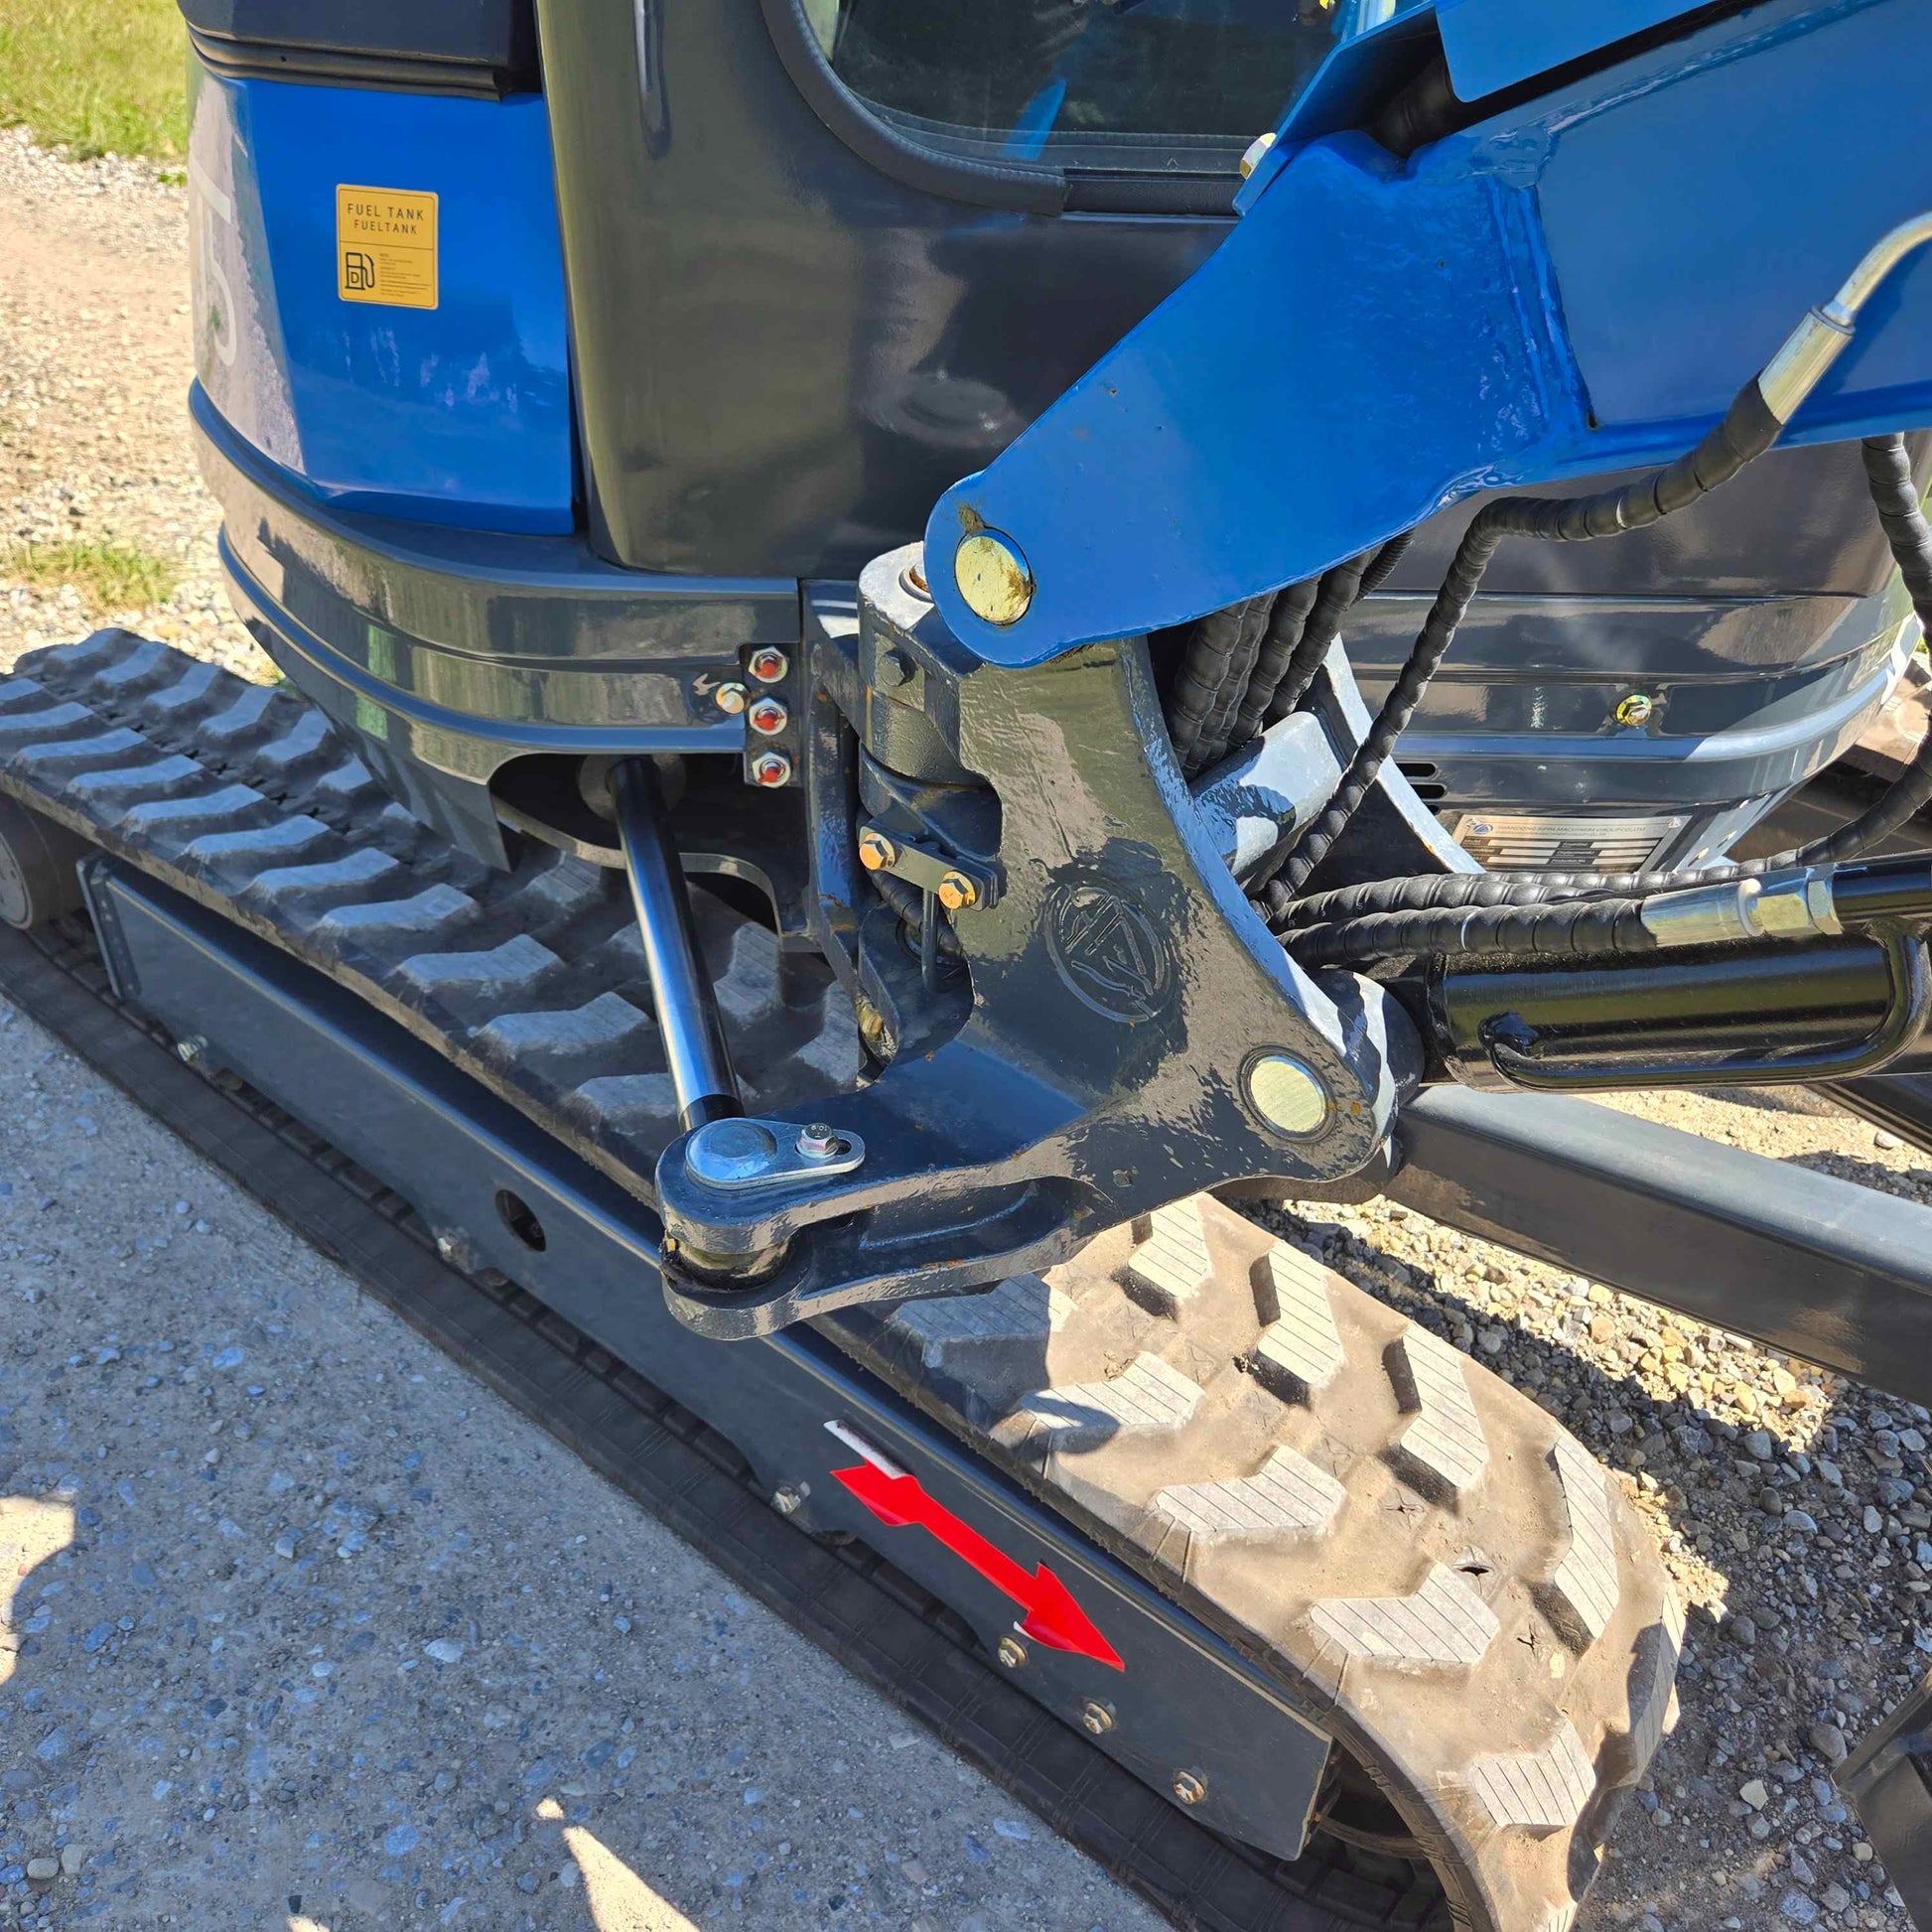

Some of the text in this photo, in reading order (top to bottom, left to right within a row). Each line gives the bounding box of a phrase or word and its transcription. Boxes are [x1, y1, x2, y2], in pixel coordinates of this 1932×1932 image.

[347, 203, 424, 221] FUEL TANK
[353, 219, 417, 234] FUELTANK
[350, 271, 360, 284] D
